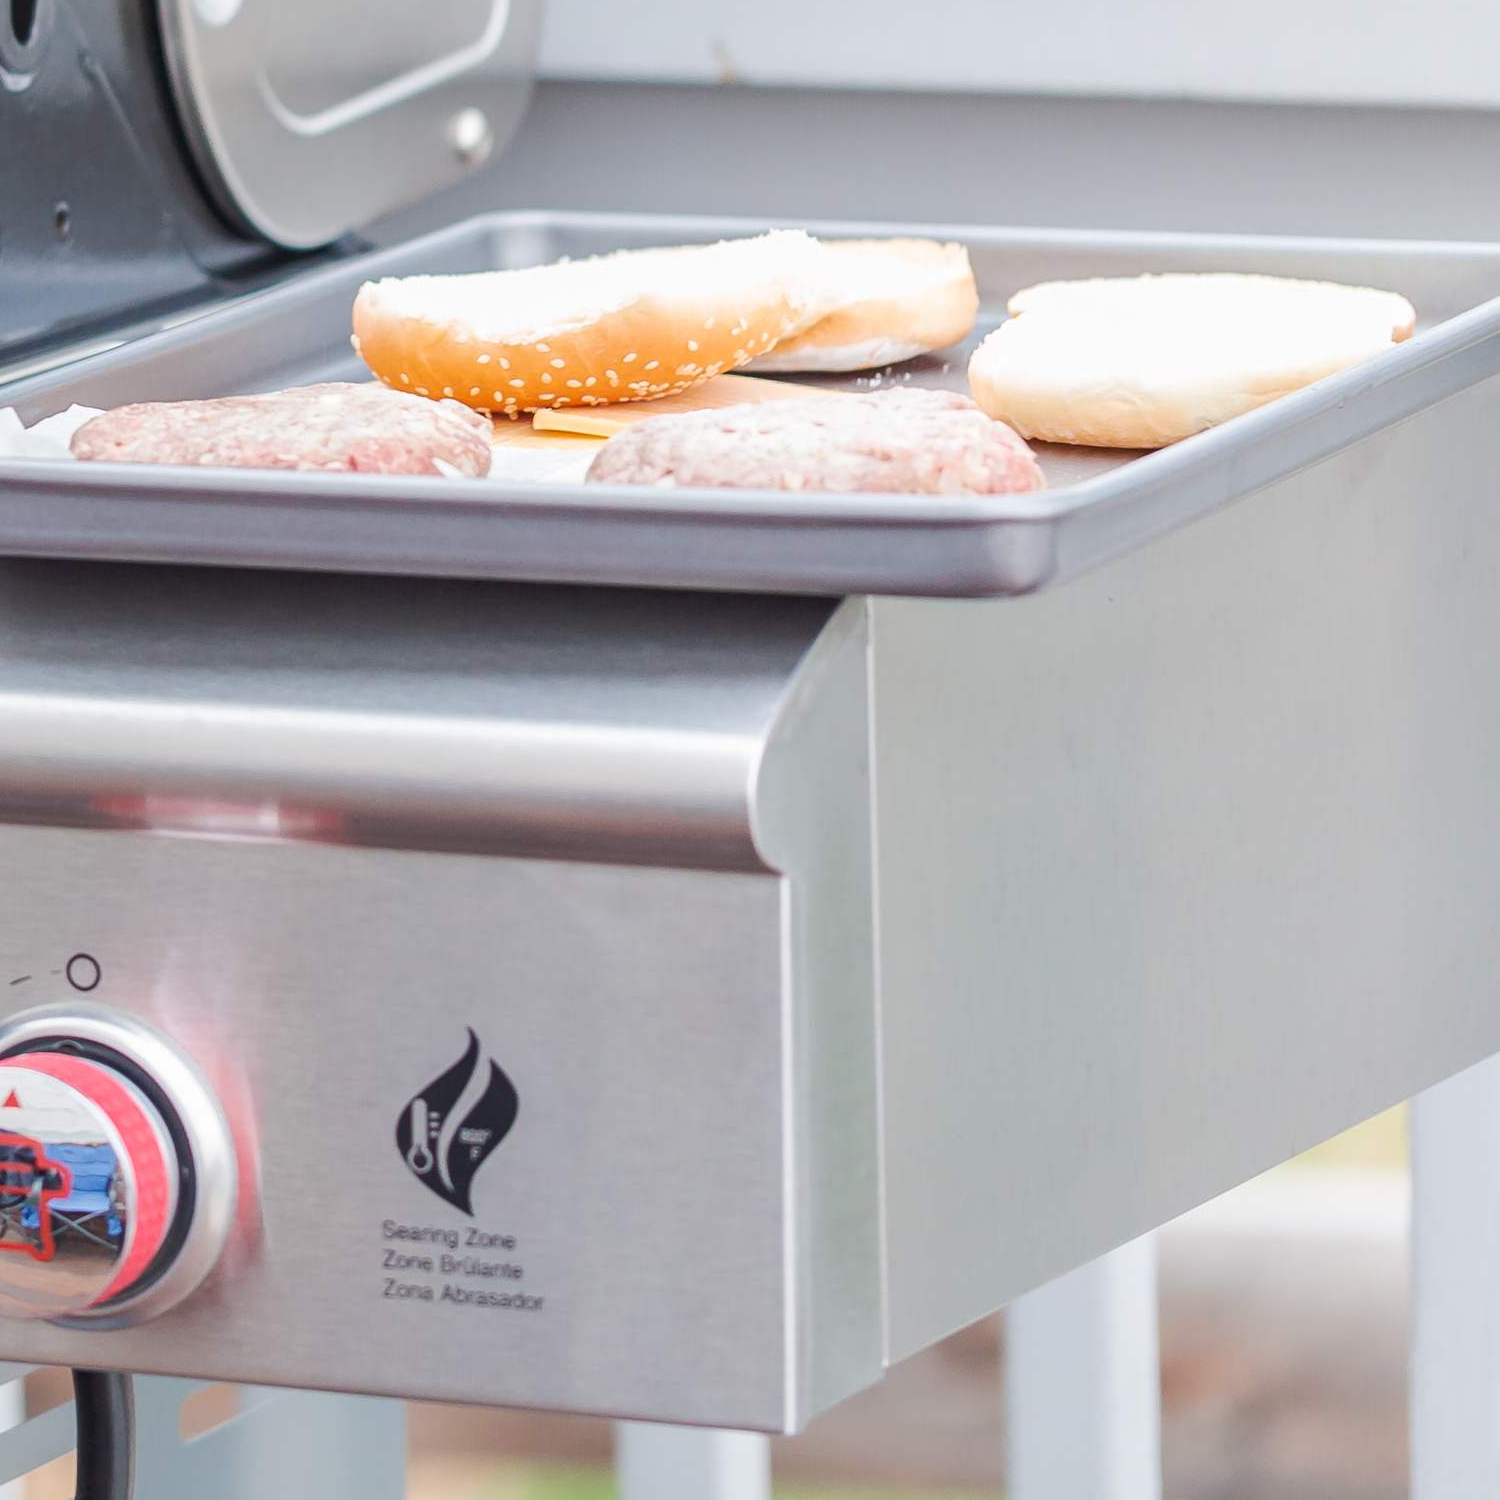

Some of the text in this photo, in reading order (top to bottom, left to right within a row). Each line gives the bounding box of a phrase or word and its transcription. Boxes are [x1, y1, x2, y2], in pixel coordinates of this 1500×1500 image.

[383, 1220, 517, 1250] Searing Zone
[383, 1249, 433, 1272] Zone
[383, 1278, 433, 1300] Zona
